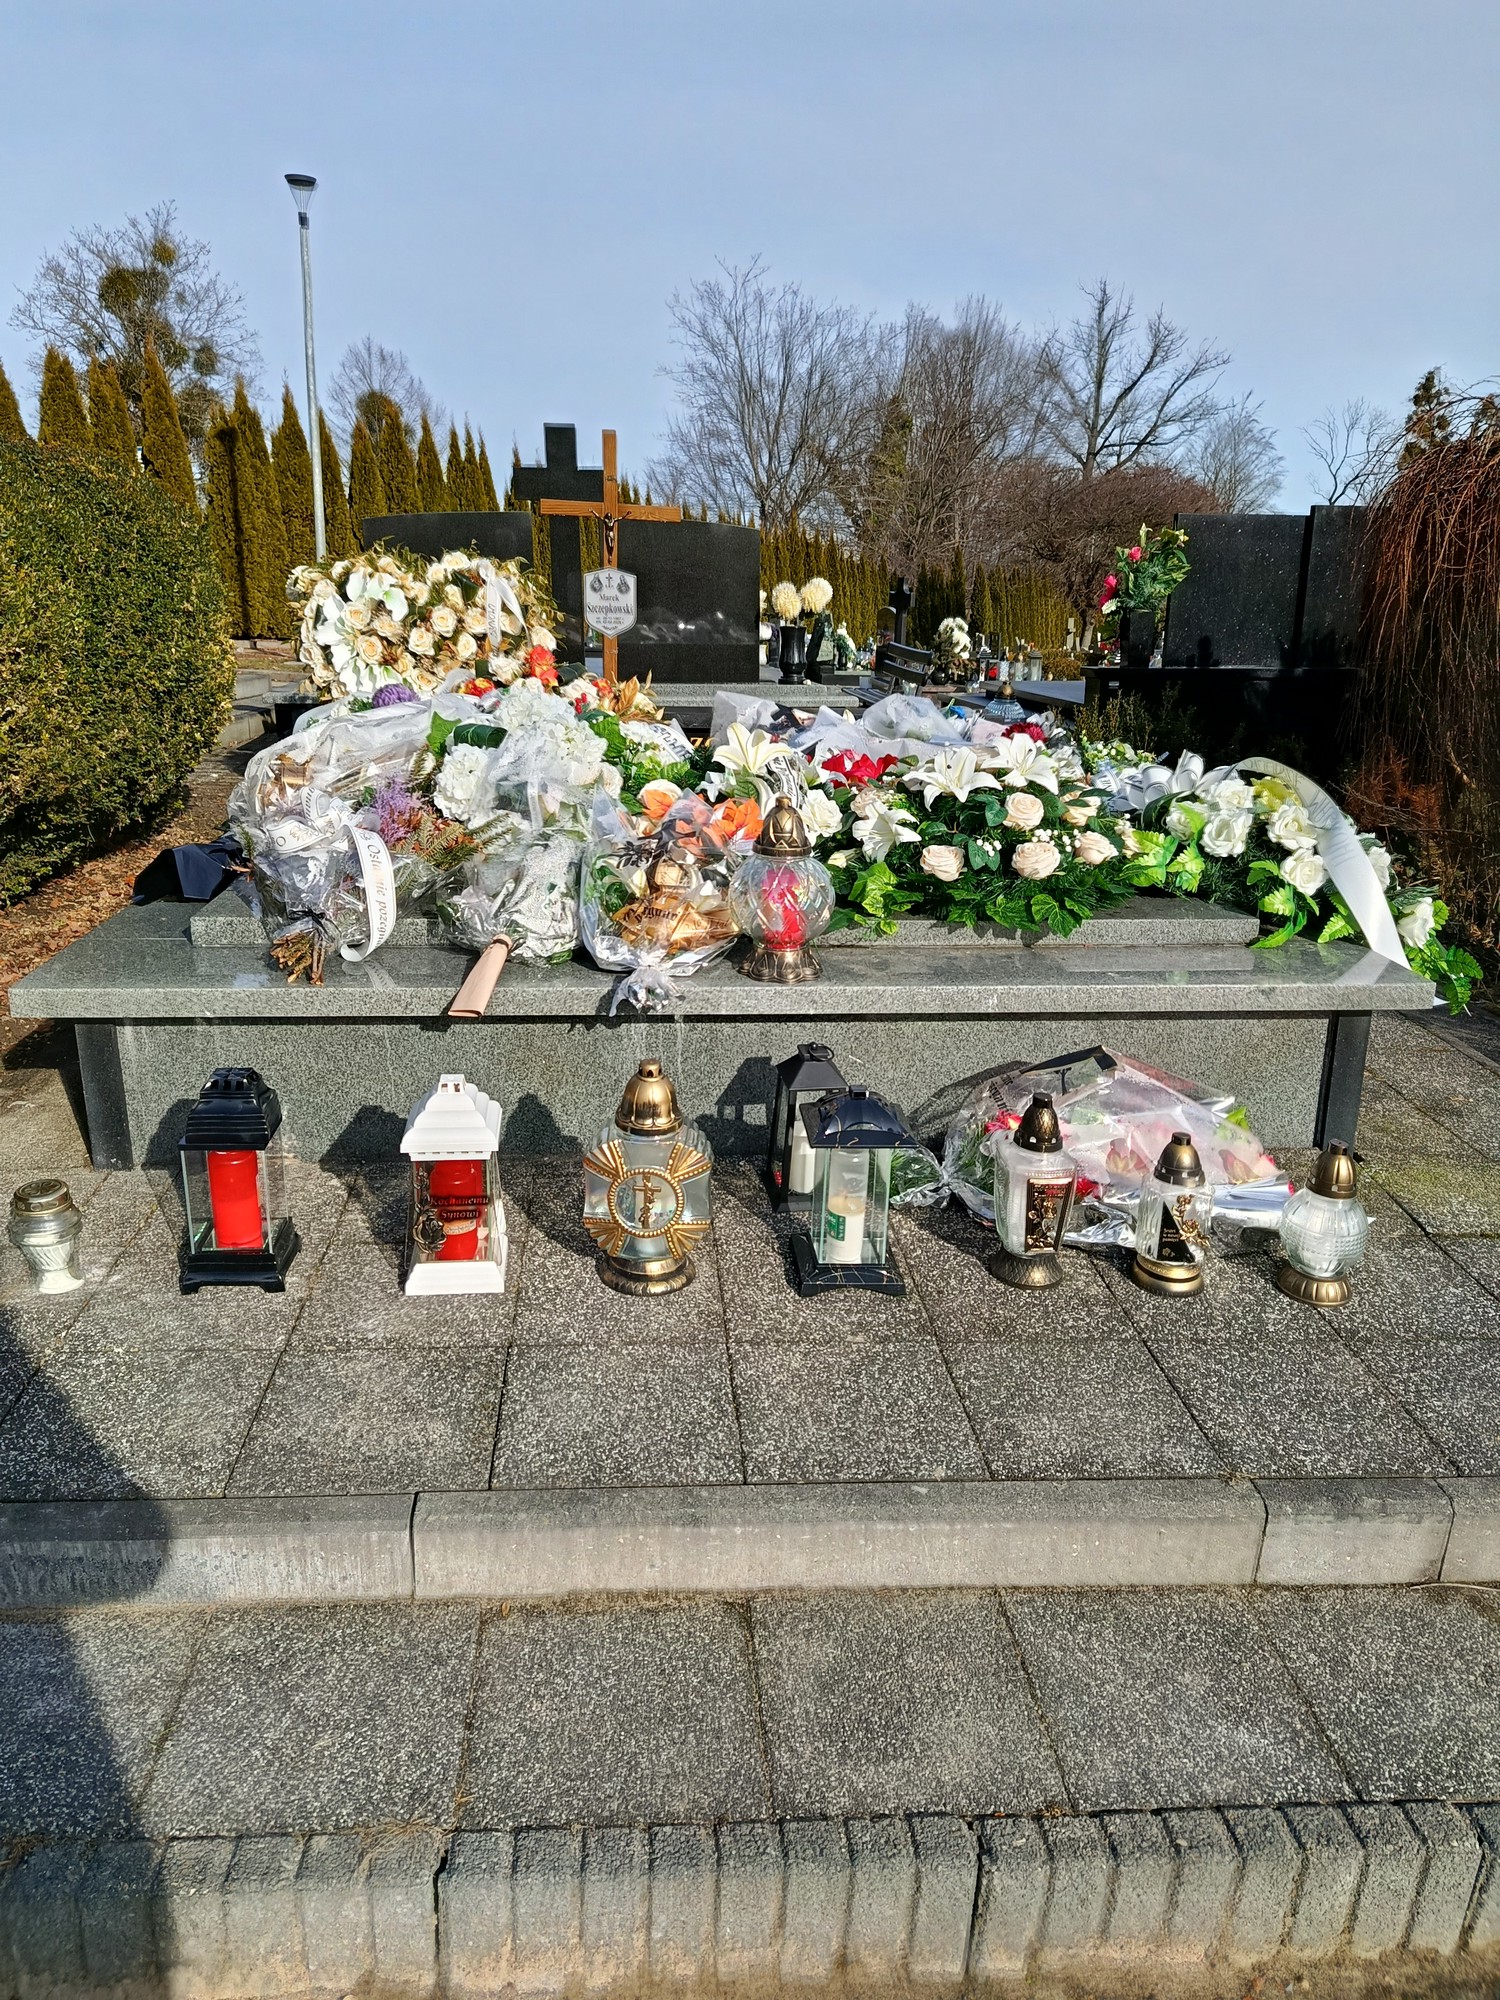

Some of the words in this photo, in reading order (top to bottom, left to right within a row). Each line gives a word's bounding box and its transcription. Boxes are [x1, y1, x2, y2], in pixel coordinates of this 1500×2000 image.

[600, 593, 620, 602] Marek
[430, 1196, 489, 1206] Kochanemu
[441, 1210, 479, 1219] Synowi
